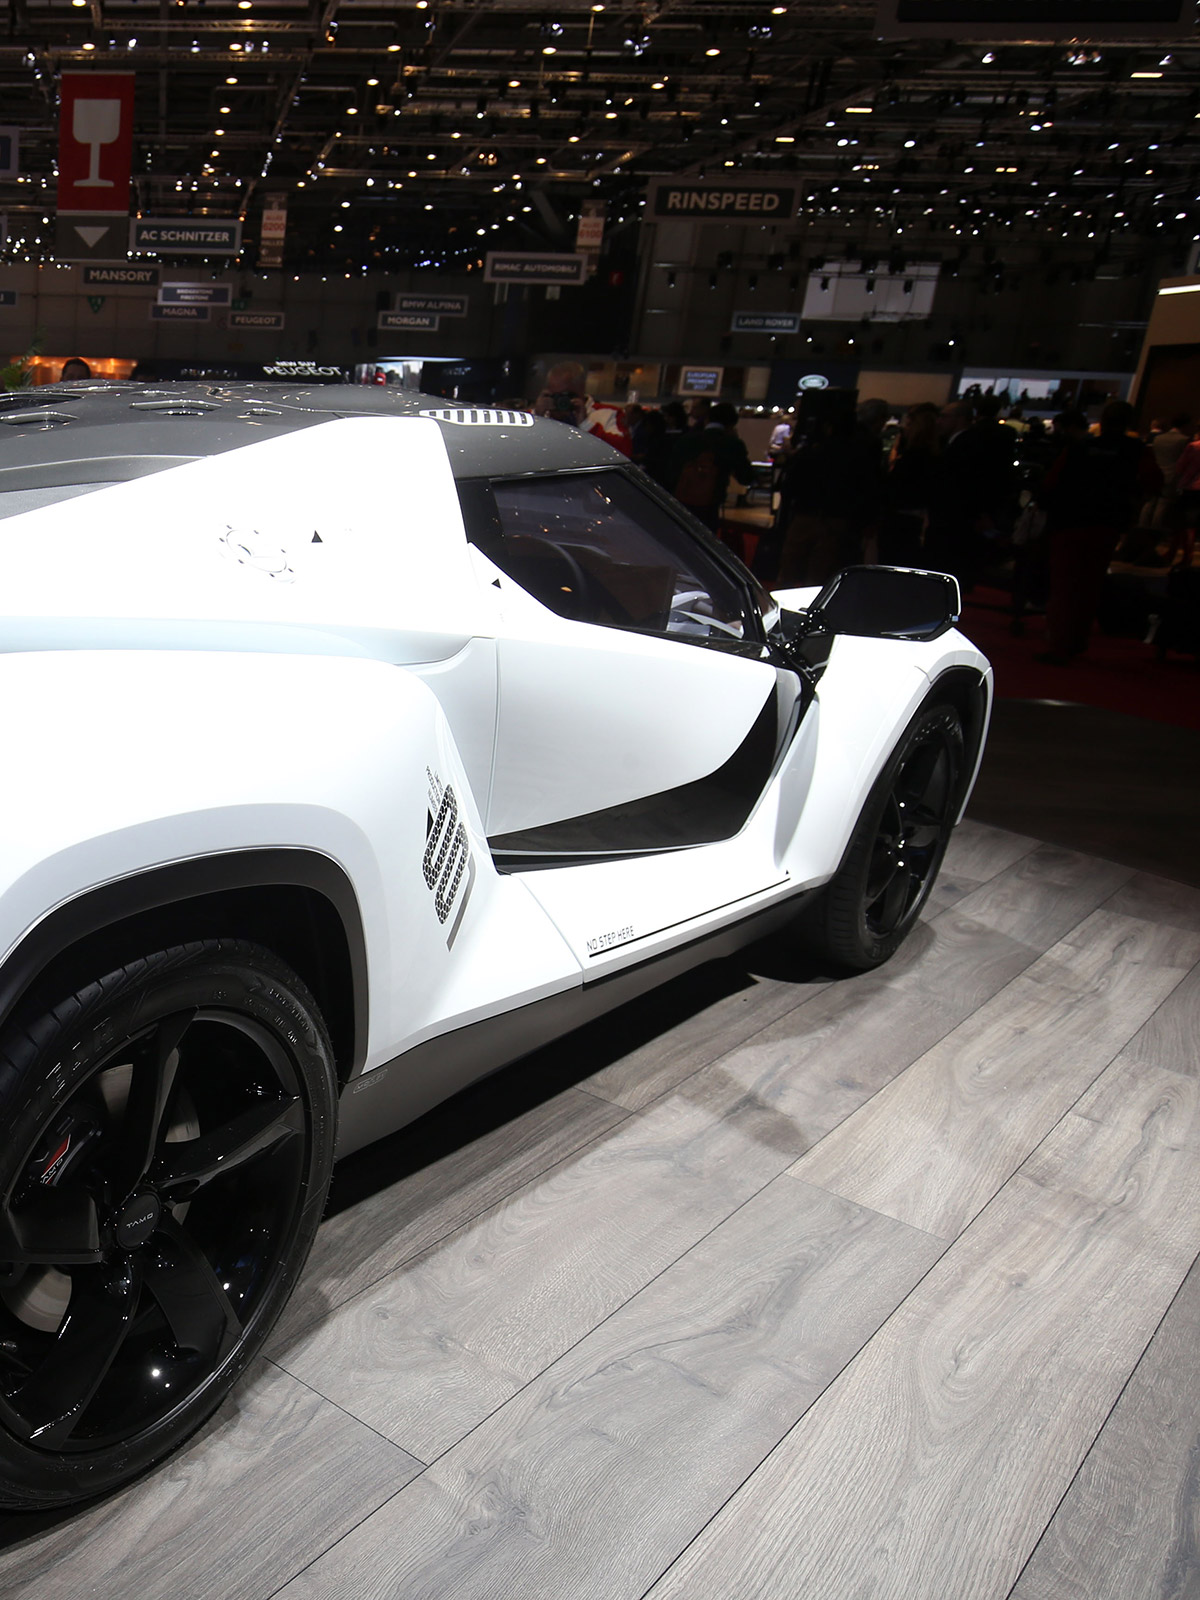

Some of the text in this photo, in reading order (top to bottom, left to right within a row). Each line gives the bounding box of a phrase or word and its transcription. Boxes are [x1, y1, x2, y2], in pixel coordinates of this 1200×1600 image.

[667, 191, 780, 212] RINSPEED
[140, 230, 230, 243] AC SCHNITZER
[89, 270, 153, 282] MANSORY
[402, 301, 461, 310] BMW ALPINA
[162, 307, 198, 317] MAGNA
[234, 316, 277, 325] PEUGEOT
[387, 316, 430, 326] MORGAN
[765, 318, 795, 327] ROVER
[262, 366, 343, 377] PEUGEOT
[586, 925, 635, 952] NO STEP HERE
[126, 1212, 154, 1229] TAMO
